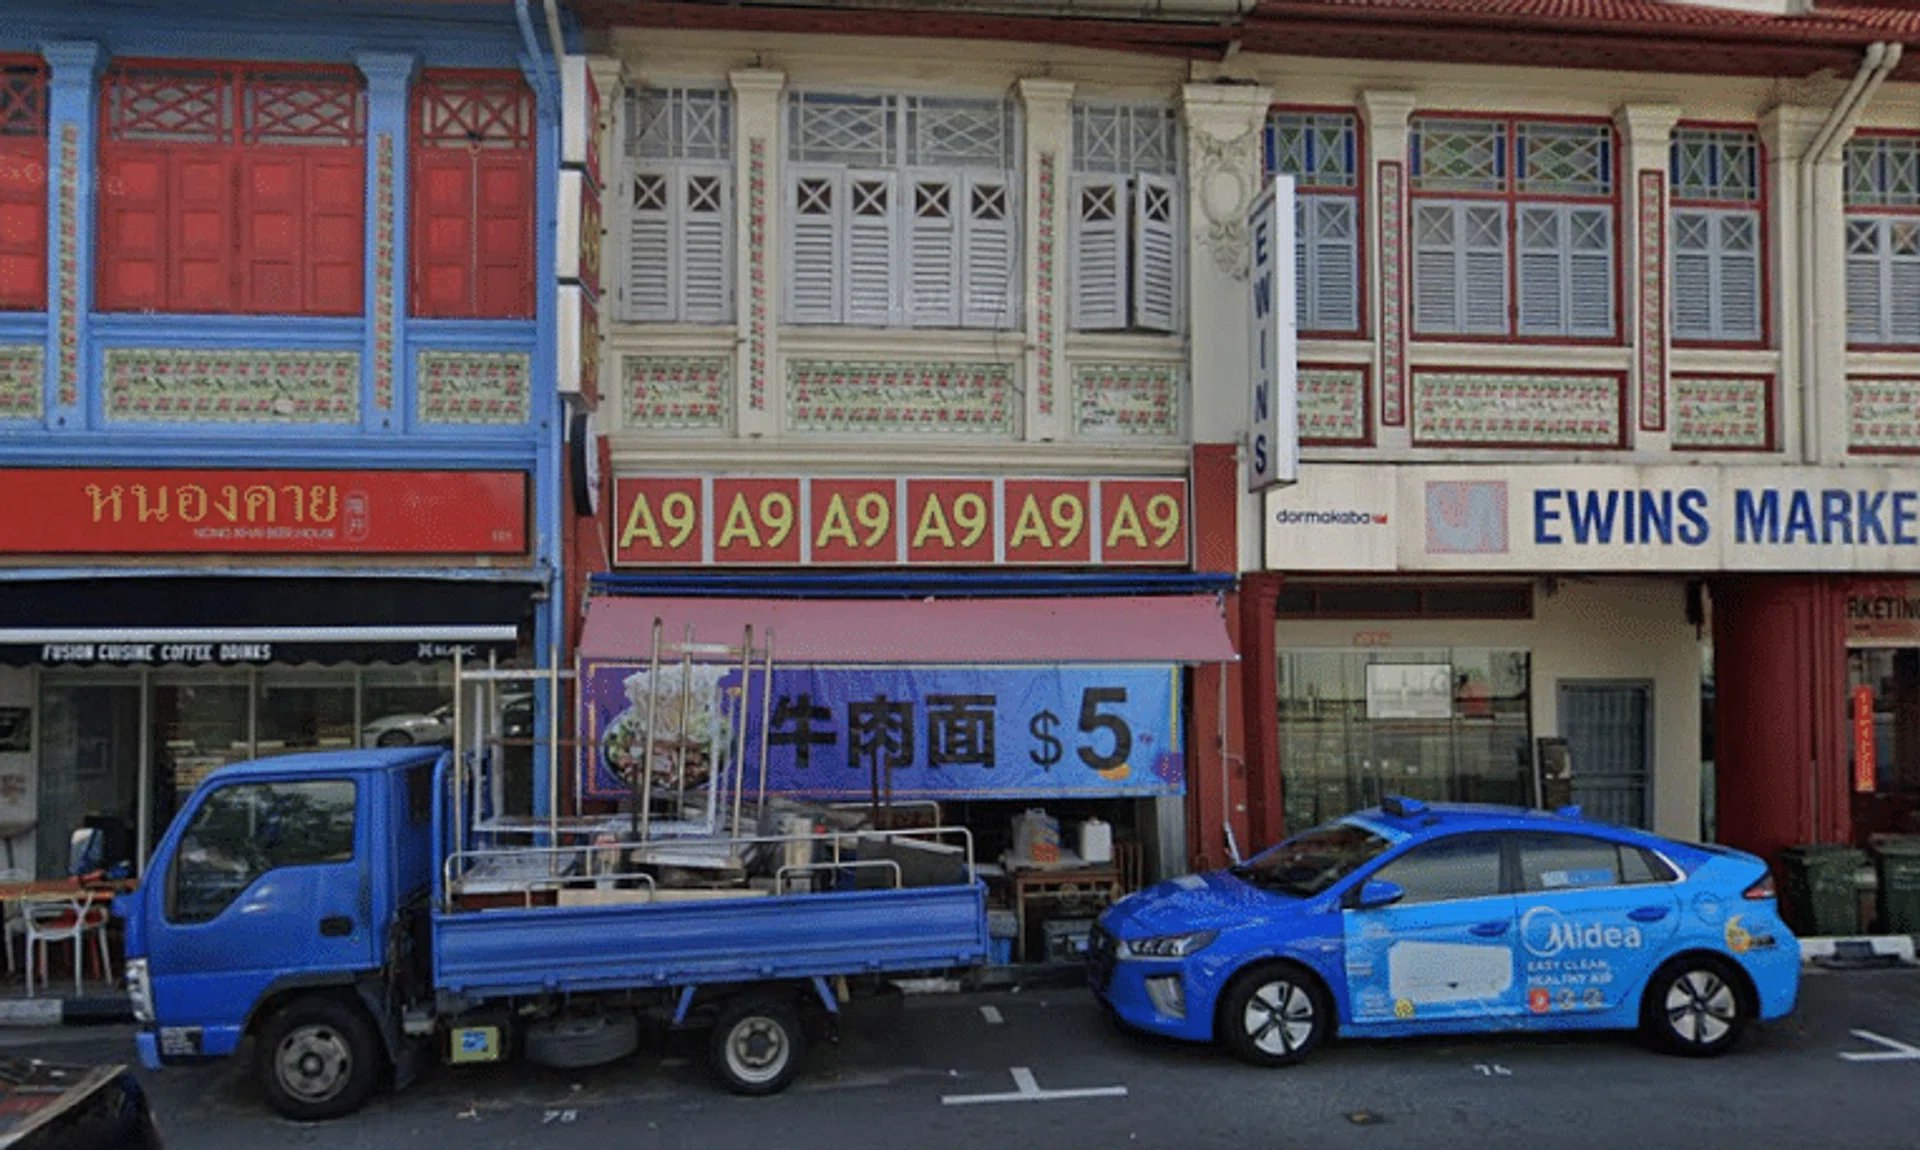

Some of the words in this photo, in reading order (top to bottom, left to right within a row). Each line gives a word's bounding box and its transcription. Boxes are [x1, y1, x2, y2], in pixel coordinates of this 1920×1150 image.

[1252, 220, 1272, 476] EWINS
[84, 483, 338, 522] หนองคาย
[619, 491, 696, 548] A9
[718, 491, 794, 548] A9
[815, 491, 890, 548] A9
[911, 492, 987, 548] A9
[1009, 492, 1084, 548] A9
[1105, 493, 1180, 548] A9
[1276, 508, 1370, 524] dormakaba
[1533, 489, 1710, 546] EWINS
[1734, 489, 1919, 545] MARKE
[42, 643, 95, 661] FUSION
[98, 643, 154, 661] CUISINE
[160, 643, 214, 661] COFFEE
[219, 643, 272, 661] DRINKS
[767, 693, 996, 769] 牛肉面
[1520, 905, 1642, 957] Midea
